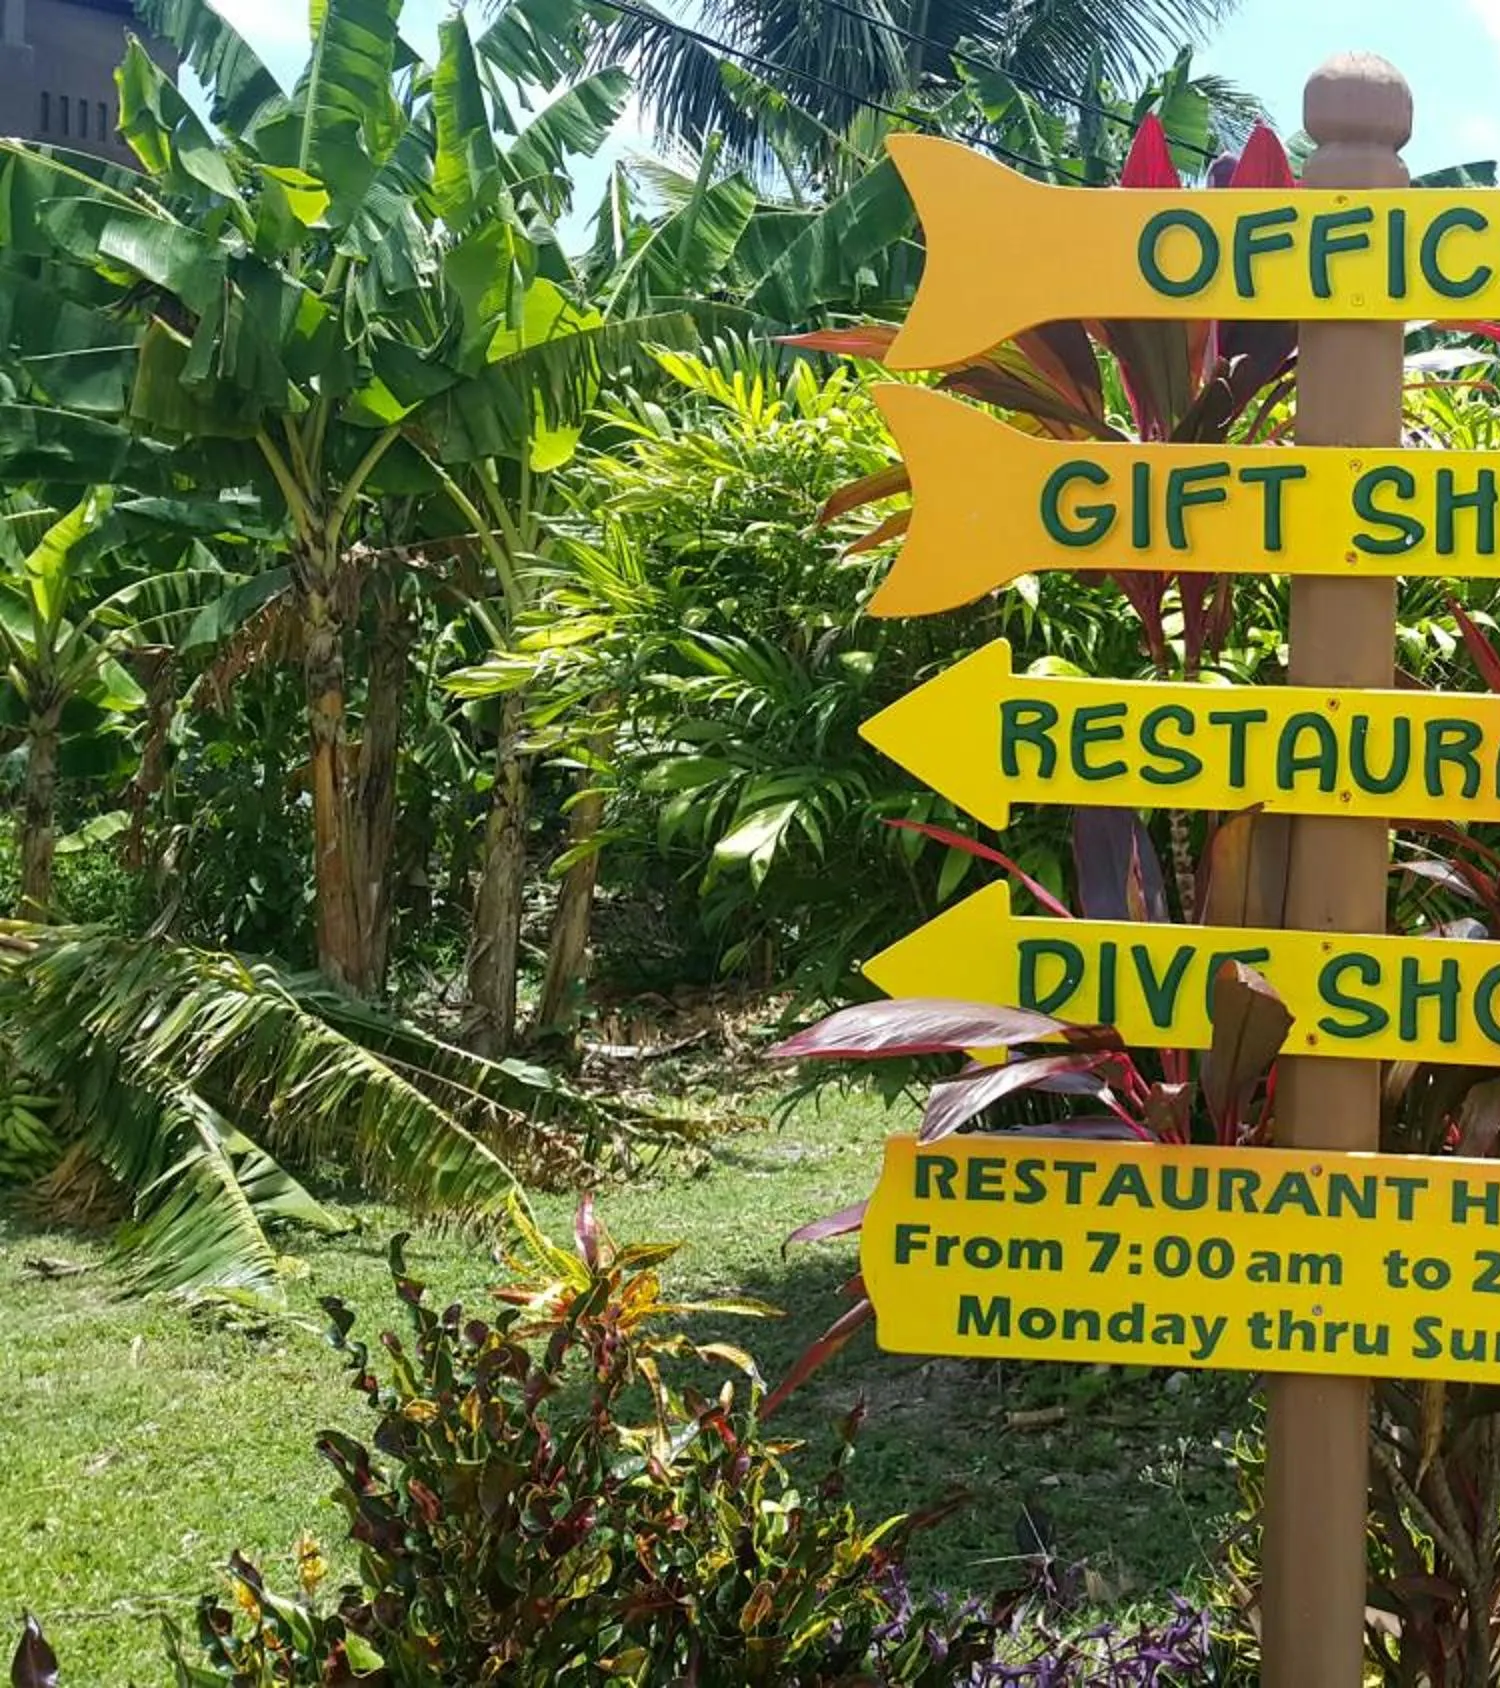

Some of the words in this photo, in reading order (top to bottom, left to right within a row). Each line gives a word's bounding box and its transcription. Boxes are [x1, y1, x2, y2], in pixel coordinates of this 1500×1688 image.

[1040, 460, 1308, 552] GIFT
[914, 1154, 1429, 1222] RESTAURANT
[894, 1223, 1064, 1273] From
[1383, 1250, 1452, 1291] to
[957, 1295, 1228, 1361] Monday
[1247, 1310, 1389, 1357] thru
